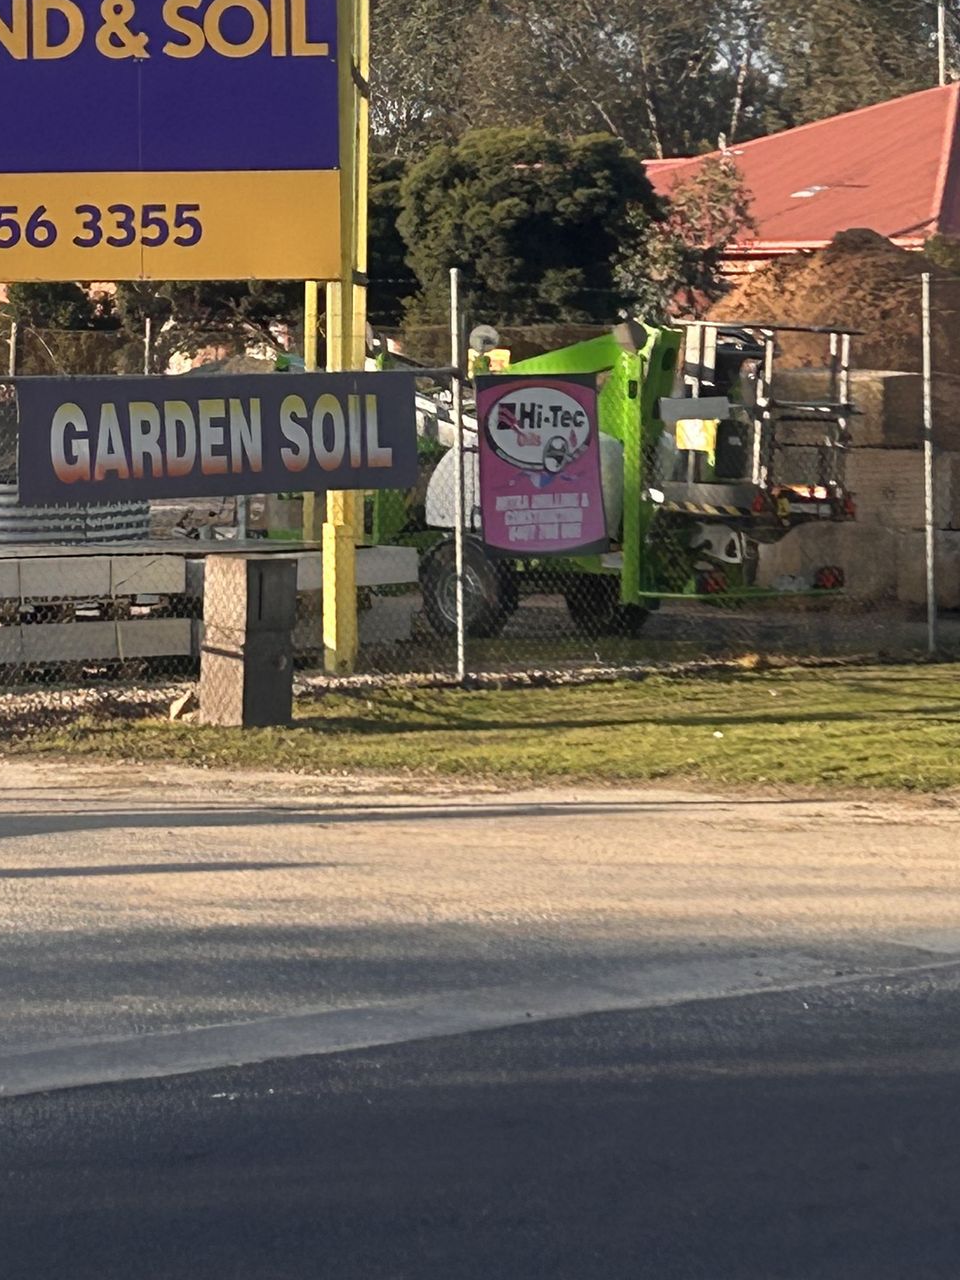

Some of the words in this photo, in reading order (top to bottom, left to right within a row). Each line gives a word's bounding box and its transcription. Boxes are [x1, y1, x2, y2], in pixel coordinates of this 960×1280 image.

[72, 204, 203, 247] 3355
[520, 402, 585, 429] Hi-Tec
[50, 397, 263, 484] GARDEN
[279, 393, 393, 472] SOIL
